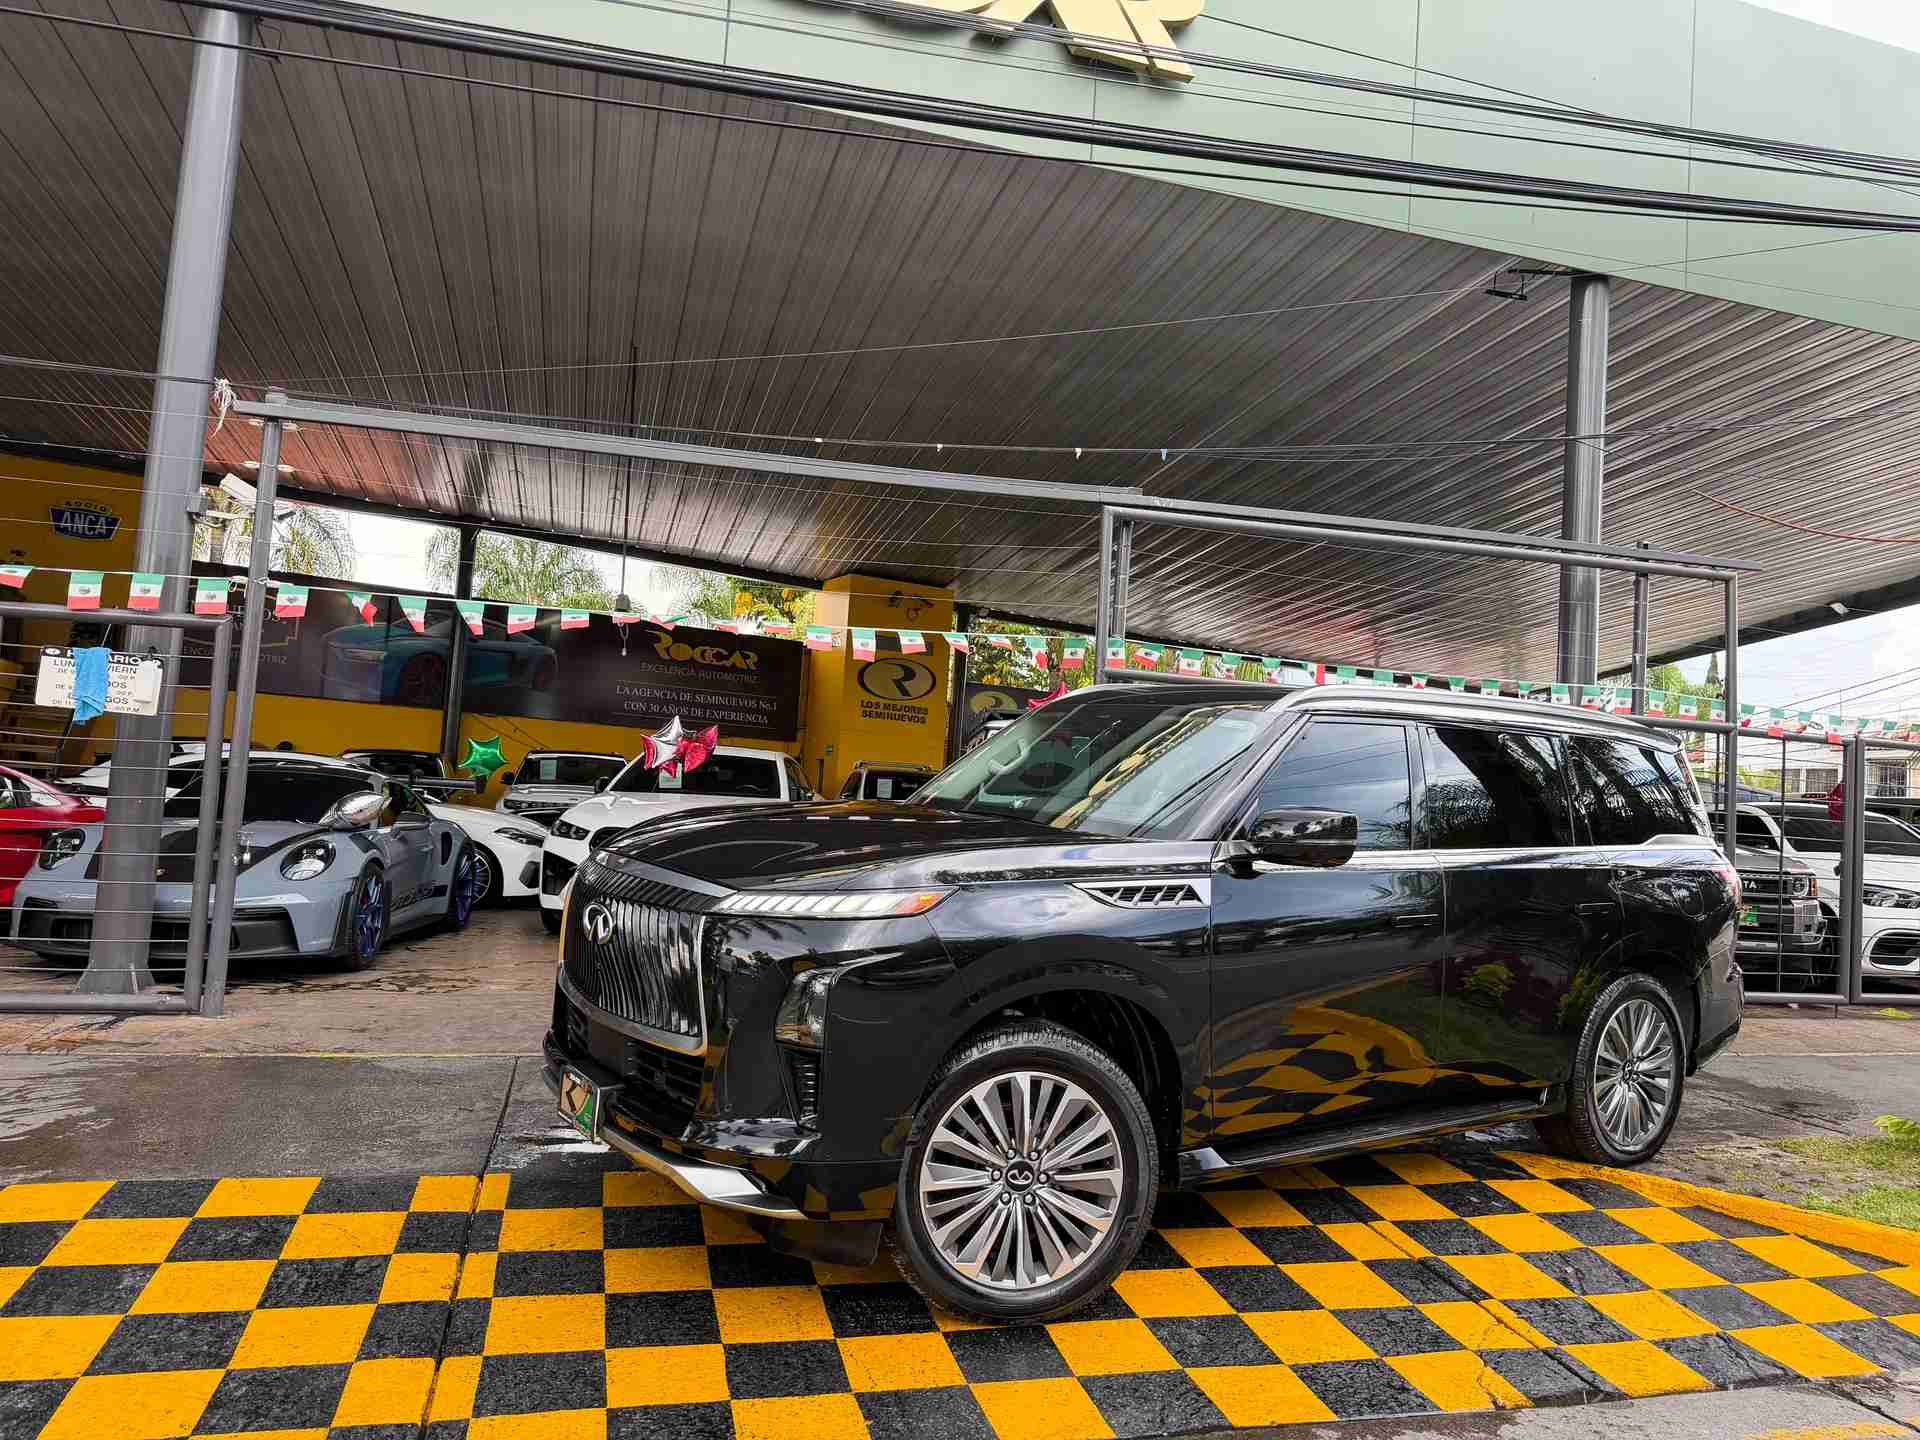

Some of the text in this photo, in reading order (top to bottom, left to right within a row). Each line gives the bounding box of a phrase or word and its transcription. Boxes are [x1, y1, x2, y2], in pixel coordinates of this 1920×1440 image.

[61, 511, 106, 536] ANCA
[616, 685, 630, 696] LA
[631, 686, 678, 700] AGENCIA
[679, 691, 693, 702] DE
[695, 694, 757, 708] SEMINUEVOS
[861, 699, 929, 715] LOS MEJORES
[624, 700, 648, 712] CON
[660, 702, 689, 715] AÑOS
[690, 706, 705, 717] DE
[706, 707, 768, 723] EXPERIENCIA
[862, 709, 928, 724] SEMINUEVOS
